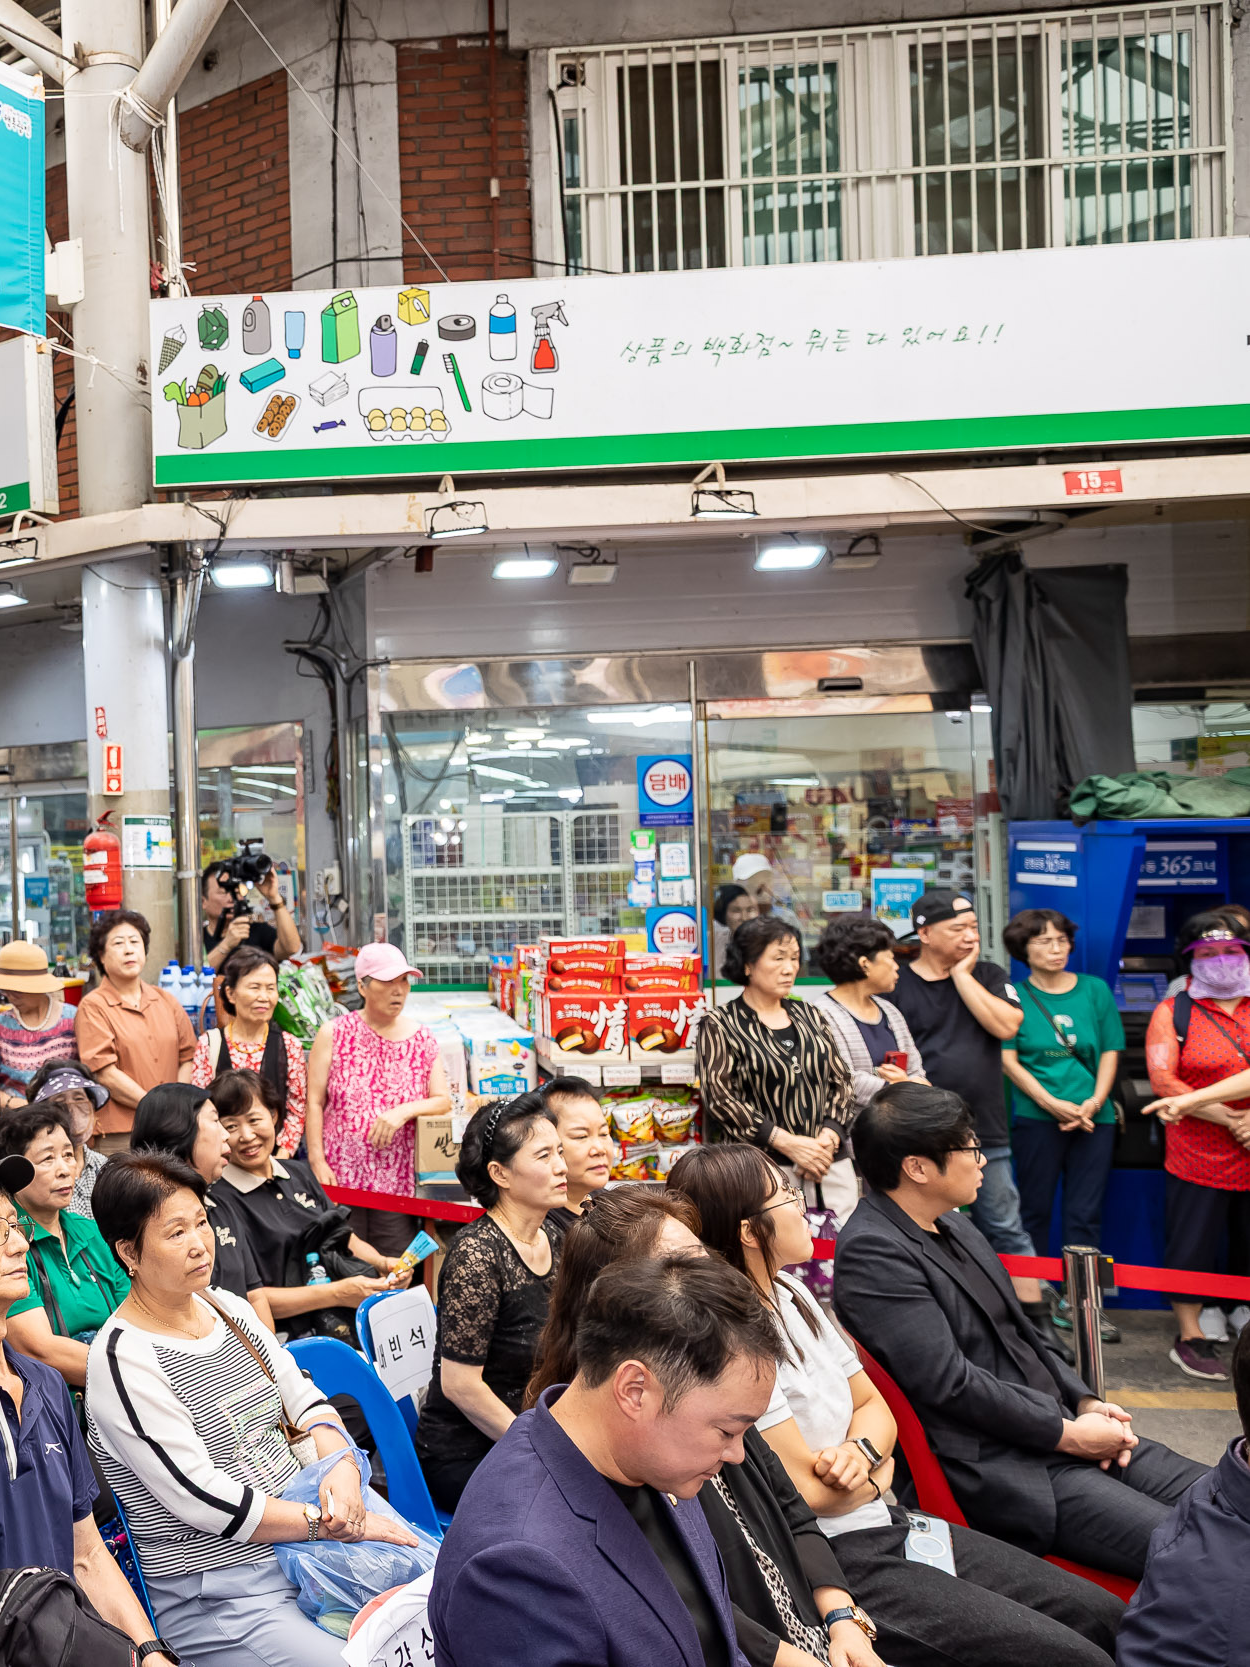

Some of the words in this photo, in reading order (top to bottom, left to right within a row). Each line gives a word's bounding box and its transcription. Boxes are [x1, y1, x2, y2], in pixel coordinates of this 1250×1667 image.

[620, 338, 691, 367] 상품의
[867, 333, 890, 346] 다
[1078, 471, 1103, 489] 15
[648, 773, 688, 791] 담배
[658, 925, 696, 944] 담배
